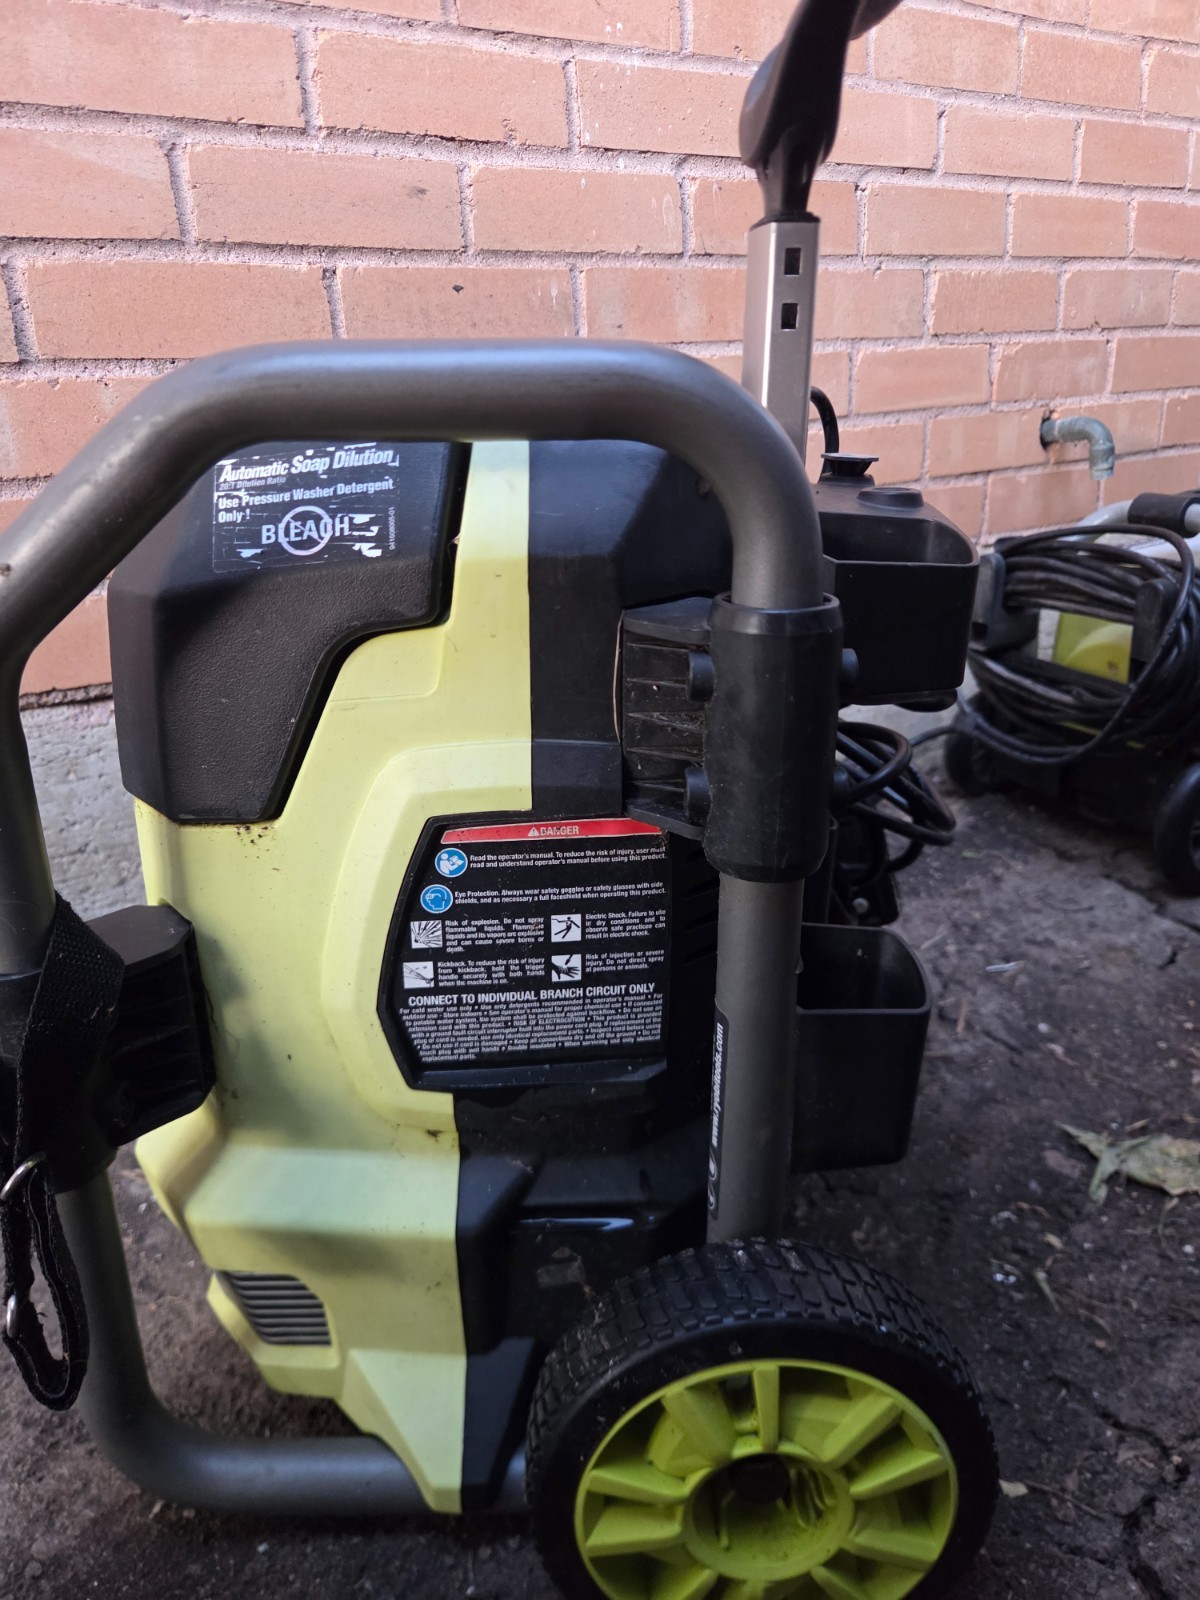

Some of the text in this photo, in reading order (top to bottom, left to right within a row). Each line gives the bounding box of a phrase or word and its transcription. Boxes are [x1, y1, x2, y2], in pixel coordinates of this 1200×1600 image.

[219, 450, 394, 482] Automatic Soap Dilution
[218, 478, 394, 509] Use Pressure Washer Detergent
[218, 510, 242, 524] Only
[262, 517, 350, 544] BLEACH
[540, 826, 579, 836] DANGER
[408, 983, 654, 1005] CONNECT TO INDIVIDUAL BRANCH CIRCUIT ONLY
[712, 1023, 724, 1147] www.ryobitools.com
